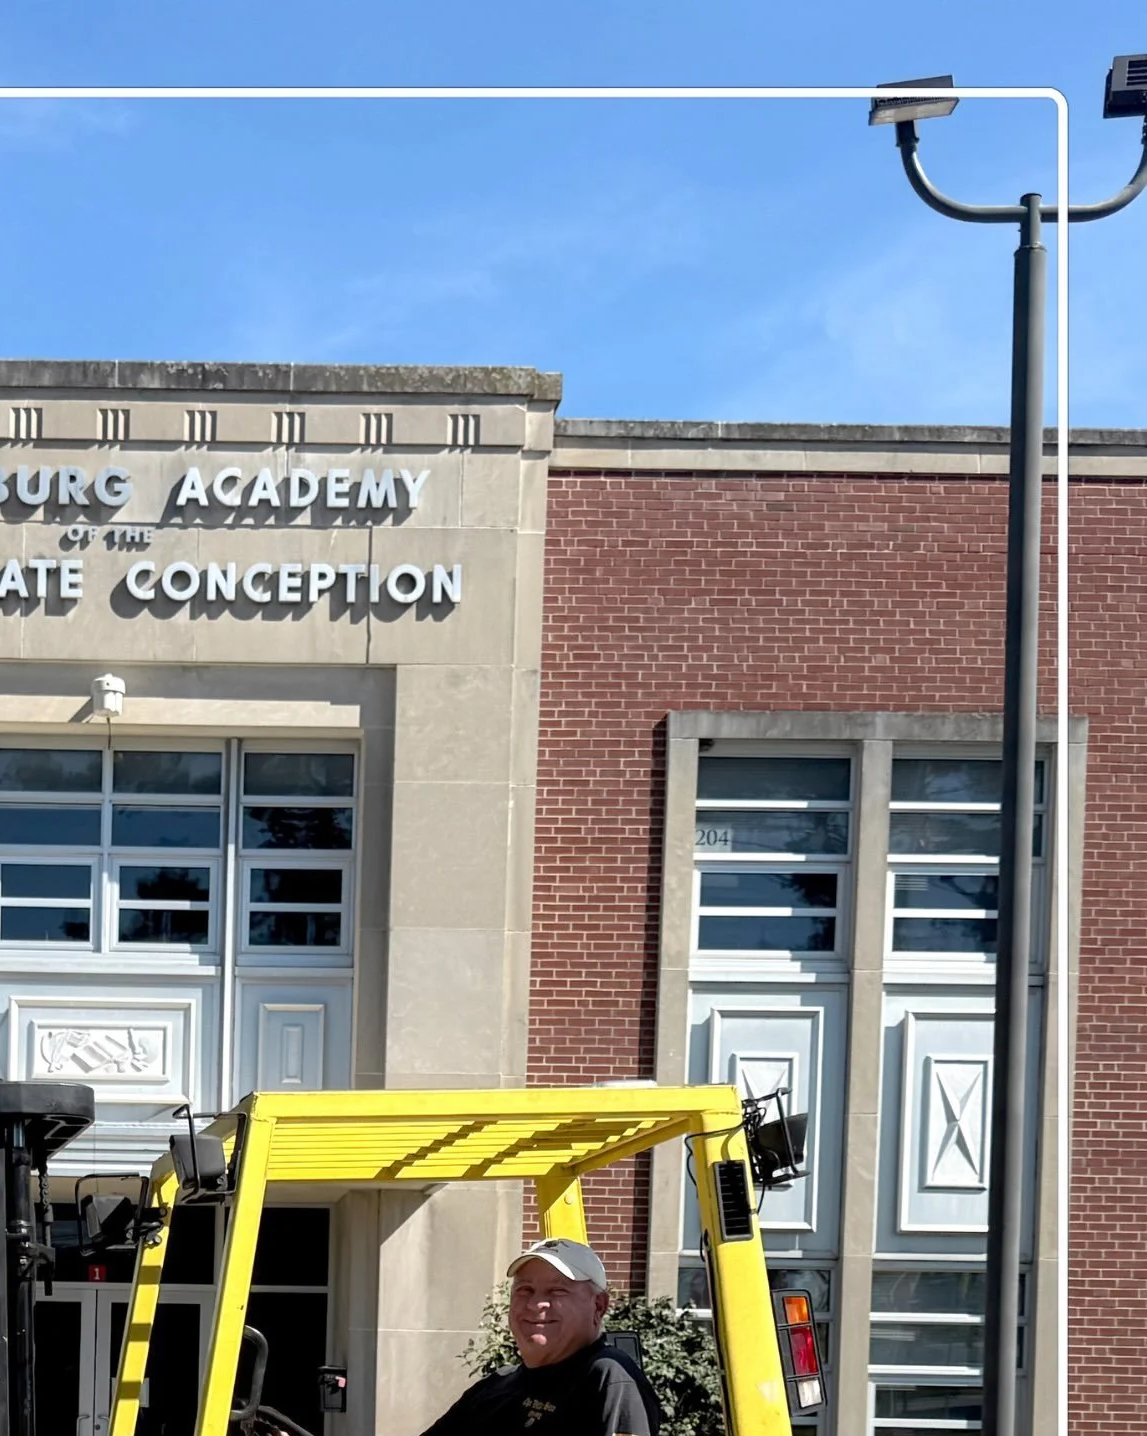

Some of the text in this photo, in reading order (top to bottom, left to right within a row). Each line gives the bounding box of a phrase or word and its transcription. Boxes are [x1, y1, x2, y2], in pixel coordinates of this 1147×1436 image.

[176, 466, 431, 509] ACADEMY
[66, 525, 153, 543] OF THE
[126, 560, 462, 604] CONCEPTION
[695, 829, 729, 846] 204
